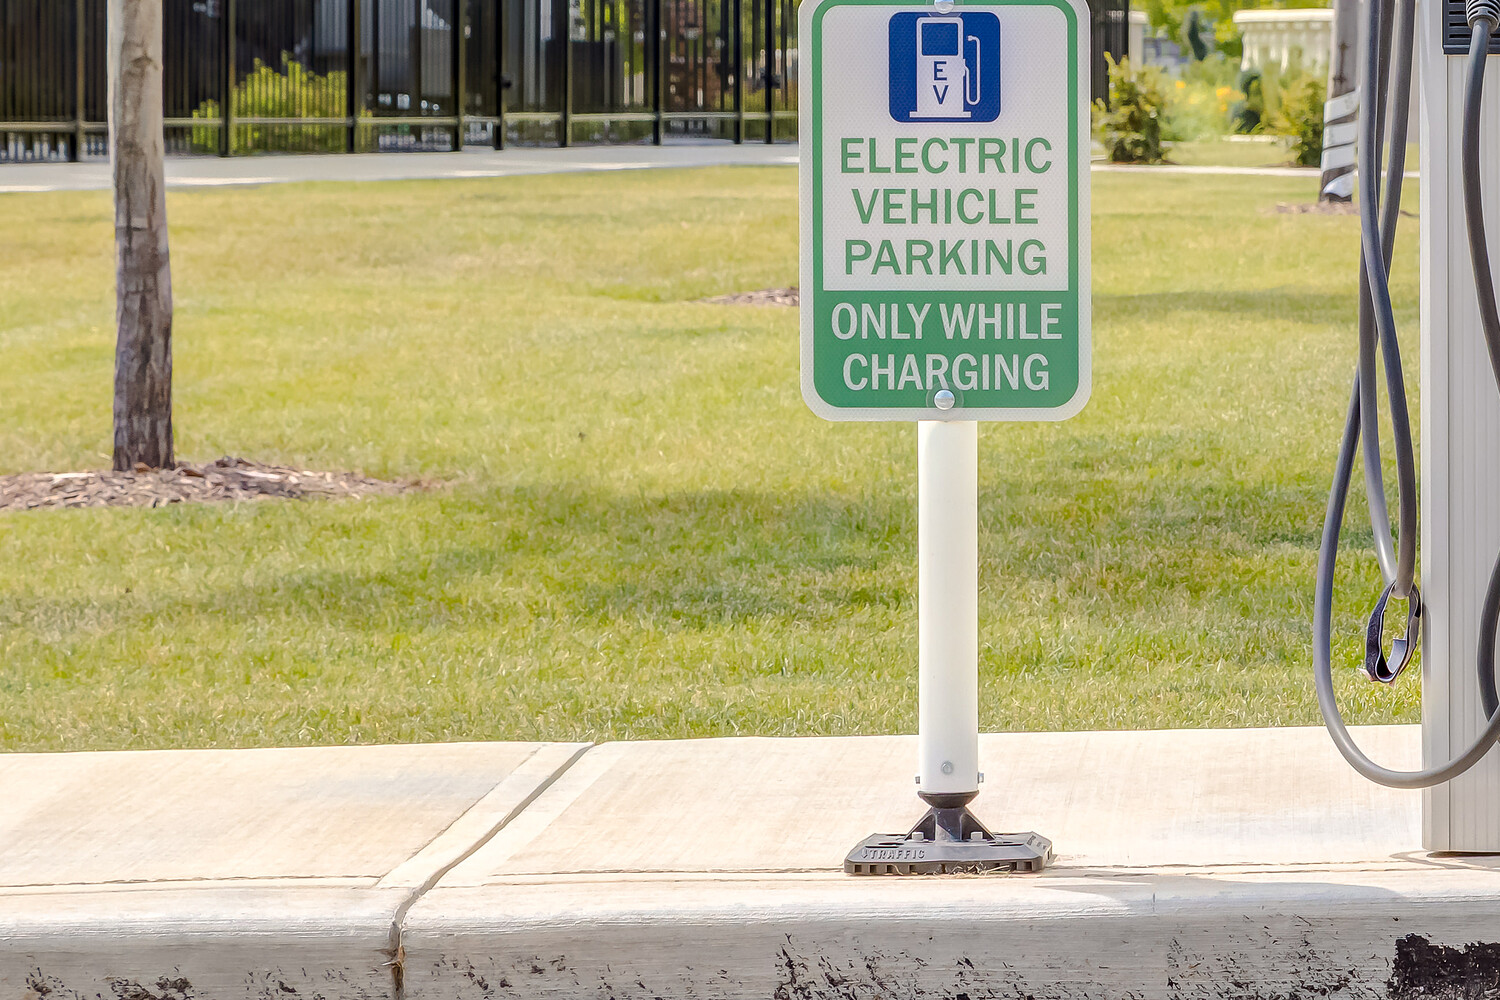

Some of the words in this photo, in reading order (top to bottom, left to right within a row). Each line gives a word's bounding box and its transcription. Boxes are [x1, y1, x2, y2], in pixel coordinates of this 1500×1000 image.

[840, 137, 1053, 174] ELECTRIC
[852, 188, 1039, 225] VEHICLE
[845, 239, 1048, 276] PARKING
[831, 303, 931, 340] ONLY
[939, 303, 1063, 340] WHILE
[842, 353, 1050, 391] CHARGING
